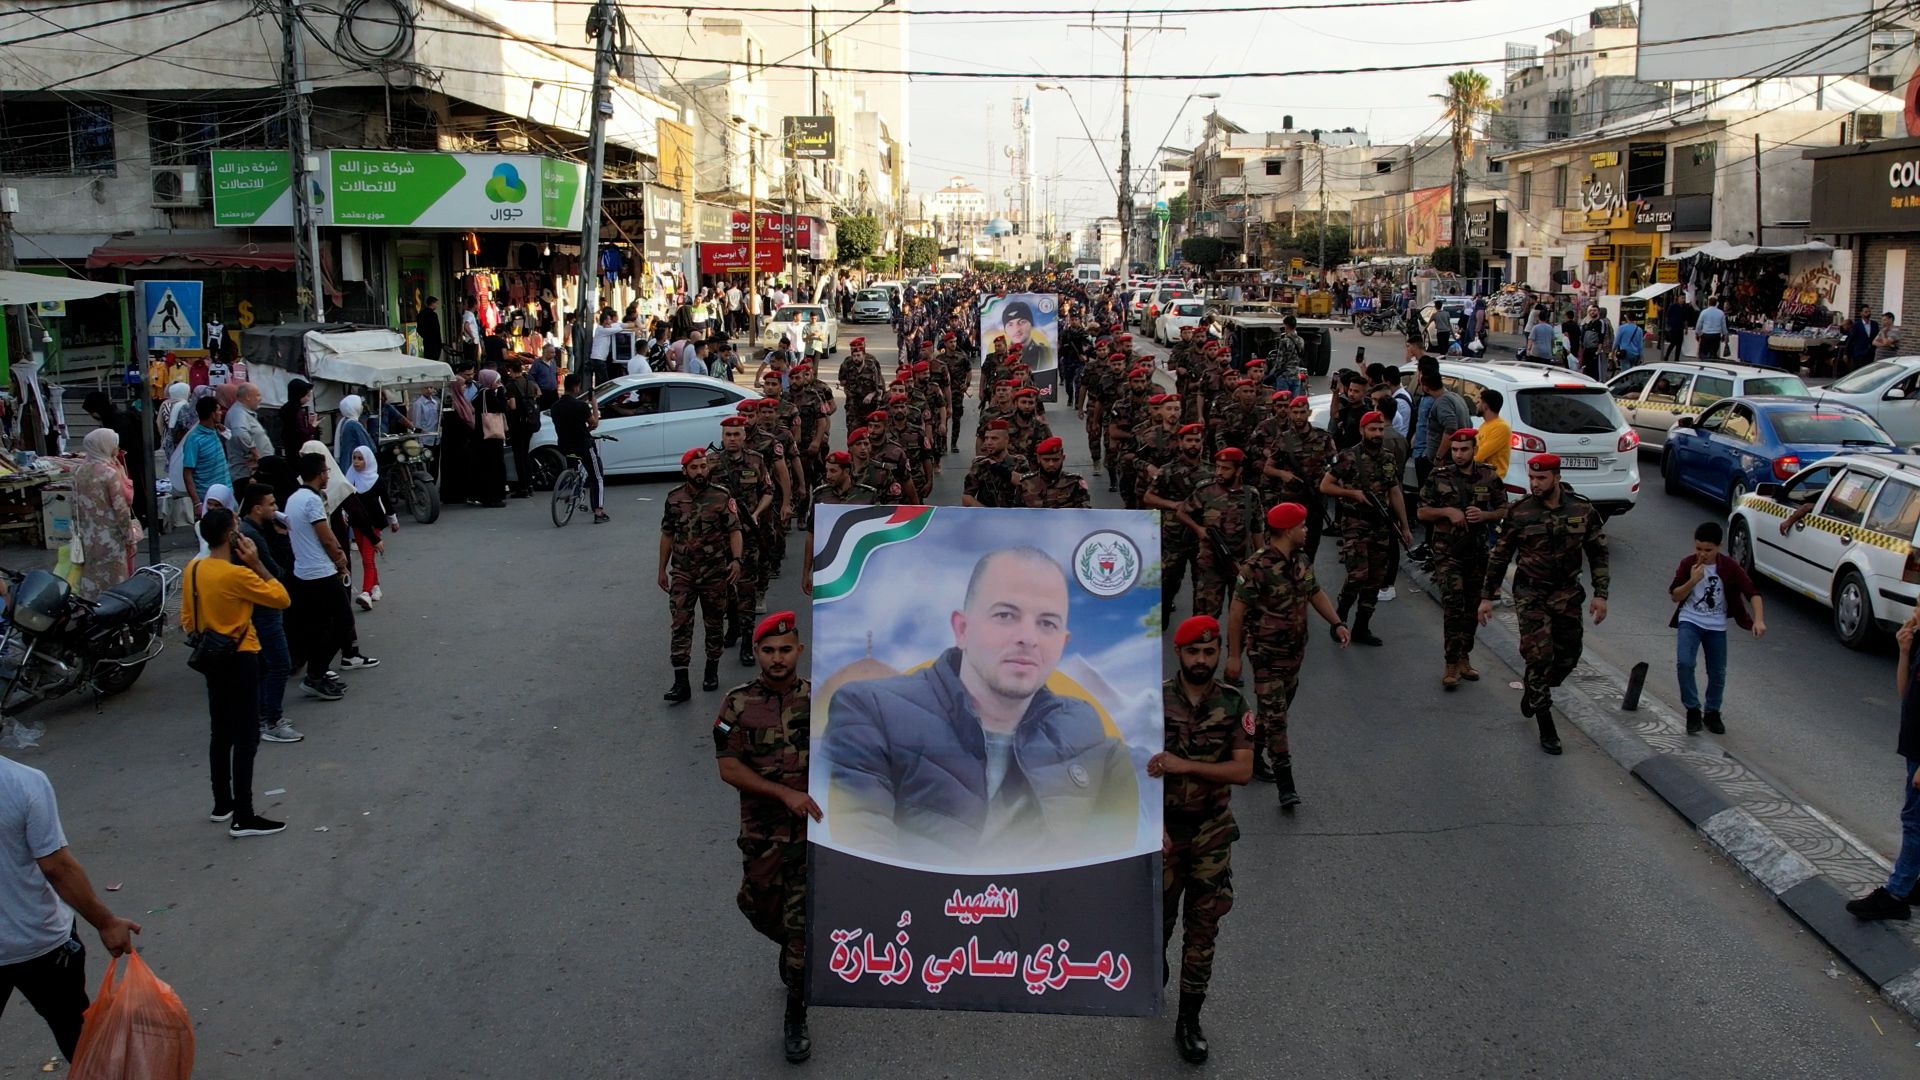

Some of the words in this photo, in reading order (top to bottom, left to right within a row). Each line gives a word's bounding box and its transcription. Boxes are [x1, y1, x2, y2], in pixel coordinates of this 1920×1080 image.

[218, 163, 235, 173] الله
[237, 162, 250, 175] حرز
[252, 161, 278, 174] شركة
[339, 161, 360, 172] الله
[363, 162, 380, 175] حرز
[382, 160, 415, 175] شركة
[220, 178, 264, 190] للاتصالات
[340, 181, 397, 193] للاتصالات
[367, 211, 385, 220] موزع
[490, 208, 523, 221] جوال
[945, 884, 1018, 924] الشهيد
[921, 936, 1018, 993] سامي
[1023, 939, 1132, 995] رمزي
